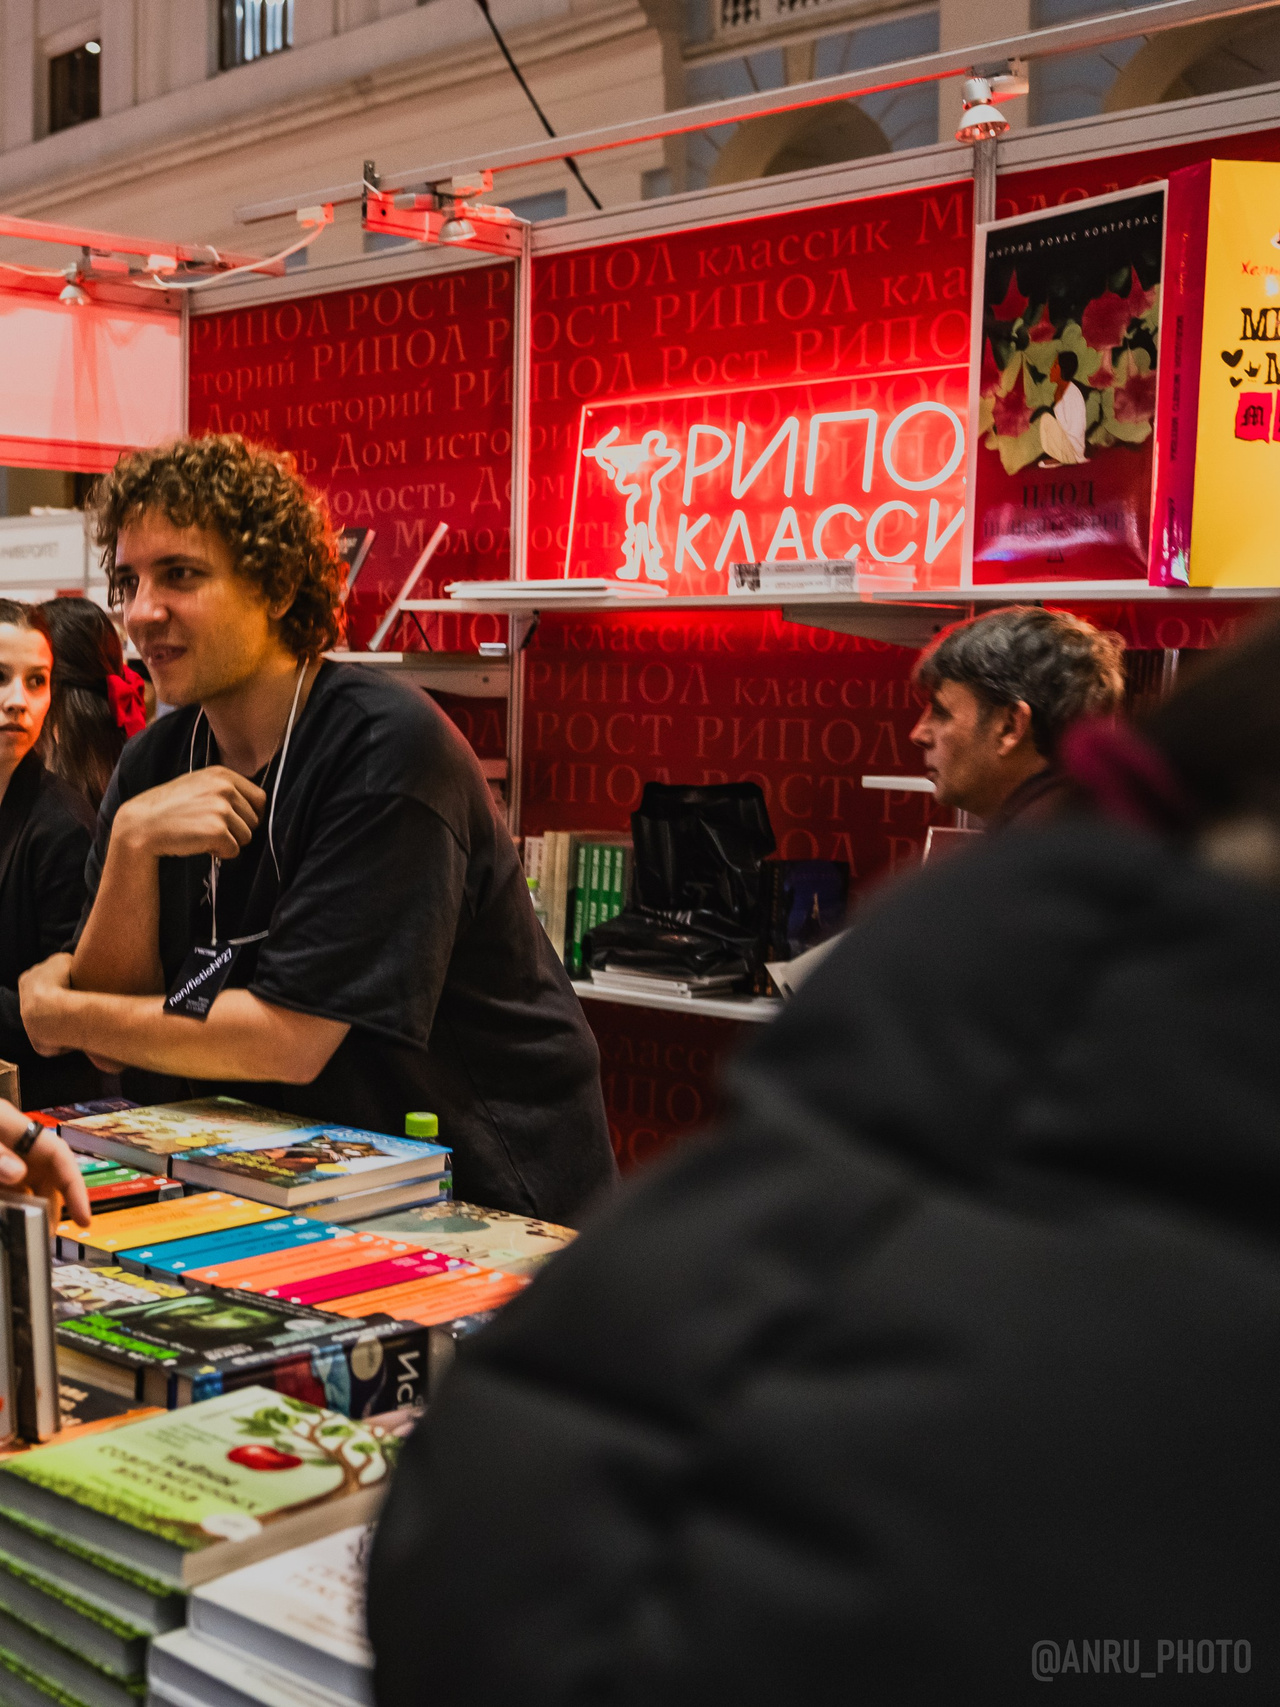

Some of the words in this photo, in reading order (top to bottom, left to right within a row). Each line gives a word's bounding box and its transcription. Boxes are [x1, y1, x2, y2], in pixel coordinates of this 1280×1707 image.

[192, 299, 330, 355] РИПОЛ
[348, 276, 467, 331] РОСТ
[699, 220, 891, 279] классик
[191, 351, 297, 400] торий
[313, 324, 467, 382] РИПОЛ
[652, 267, 859, 338] РИПОЛ
[881, 265, 969, 308] кла
[287, 377, 434, 430] историй
[660, 345, 769, 390] Рост
[792, 309, 970, 376] РИПО
[332, 432, 407, 477] Дом
[683, 400, 966, 506] РИПО
[325, 480, 456, 519] одость
[675, 498, 965, 574] КЛАССИ
[562, 622, 735, 652] классик
[528, 660, 709, 705] РИПОЛ
[536, 711, 673, 757] РОСТ
[696, 714, 905, 767] РИПОЛ
